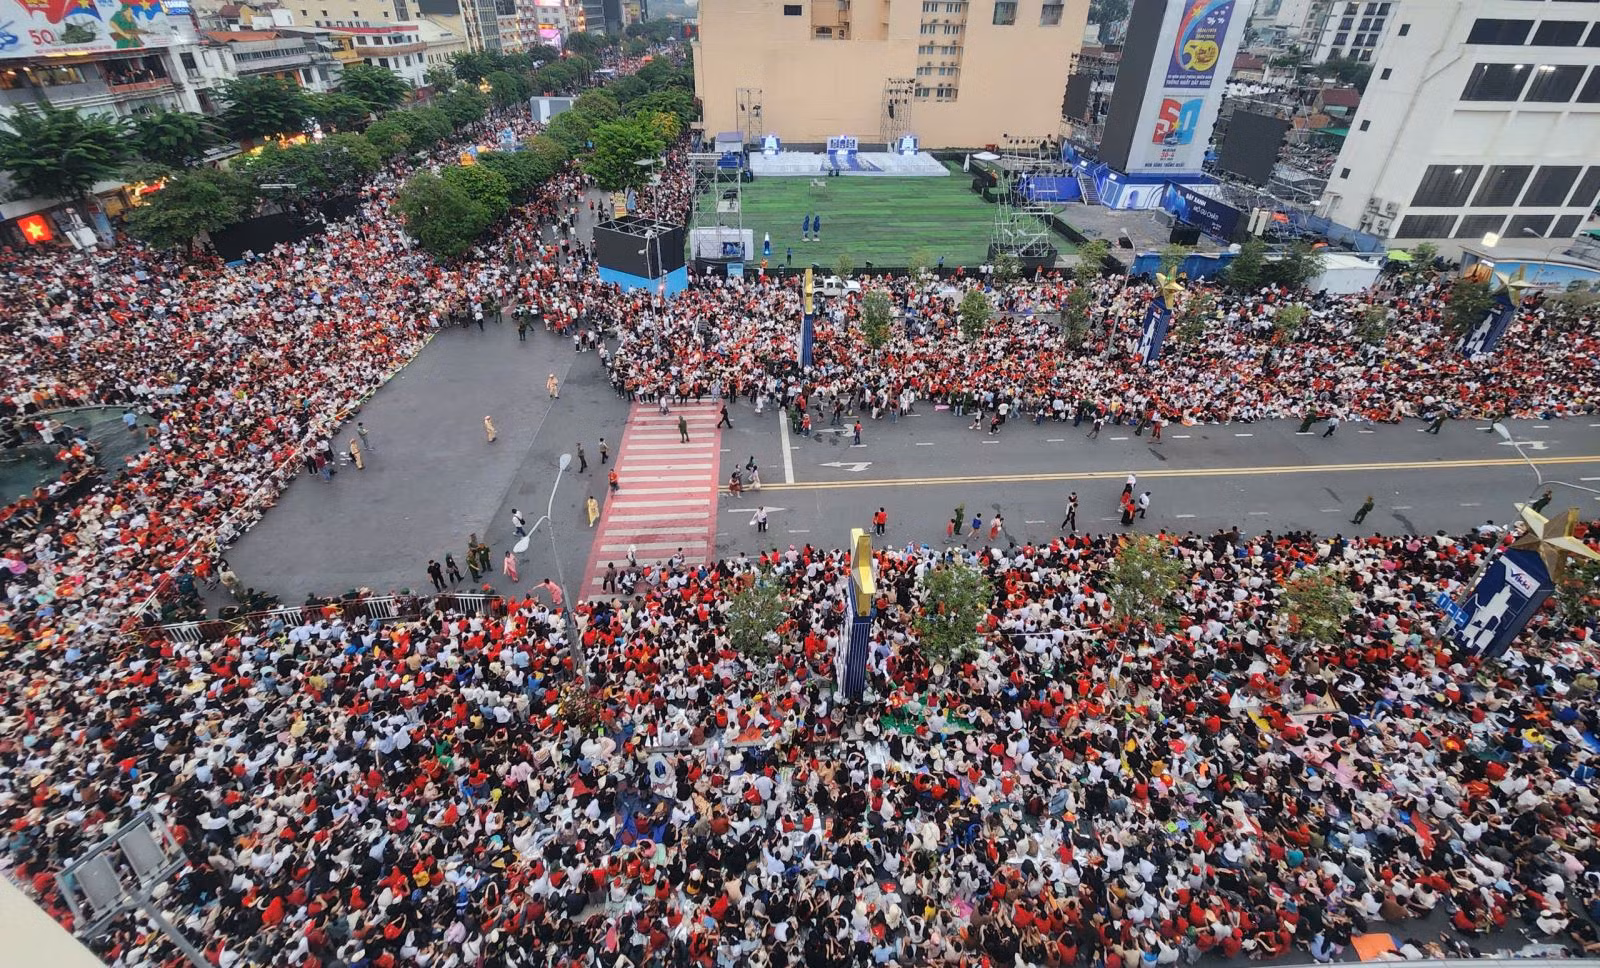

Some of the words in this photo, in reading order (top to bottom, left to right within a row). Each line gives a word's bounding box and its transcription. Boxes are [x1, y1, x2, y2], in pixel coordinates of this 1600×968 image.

[28, 29, 54, 45] 50
[1183, 39, 1219, 71] 50
[1151, 97, 1203, 145] 50
